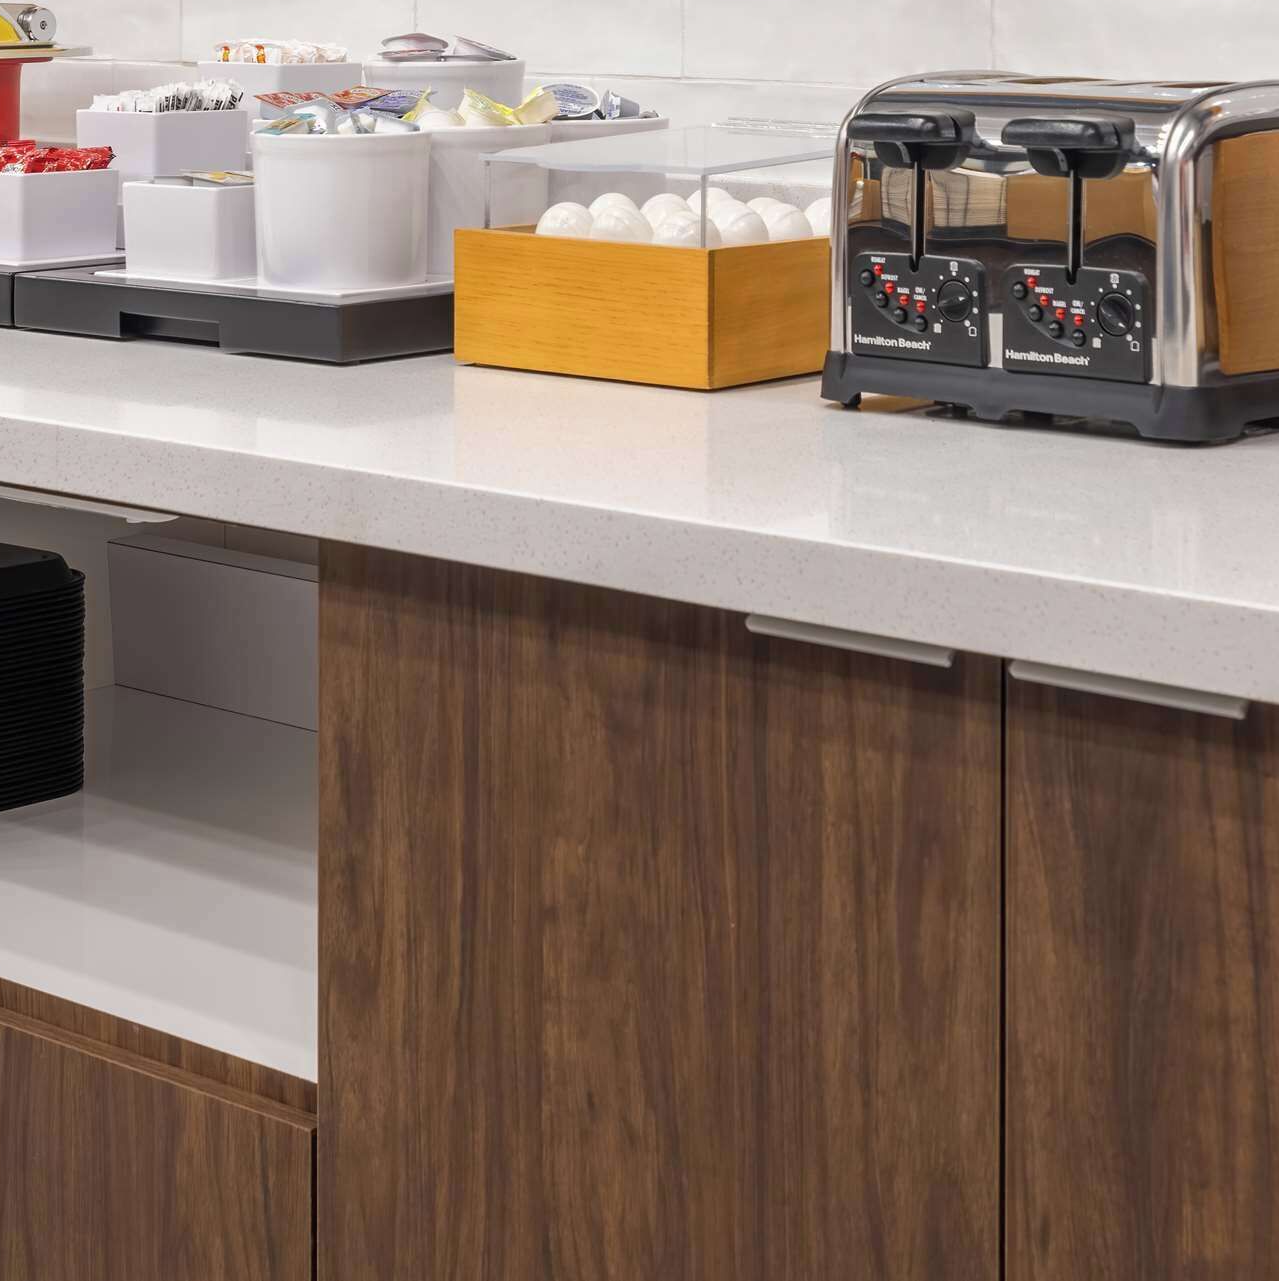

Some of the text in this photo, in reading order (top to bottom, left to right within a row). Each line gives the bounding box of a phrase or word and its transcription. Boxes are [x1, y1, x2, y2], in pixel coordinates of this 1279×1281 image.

[854, 333, 930, 350] Hamilton Beach
[1005, 348, 1089, 366] Hamilton Beach
